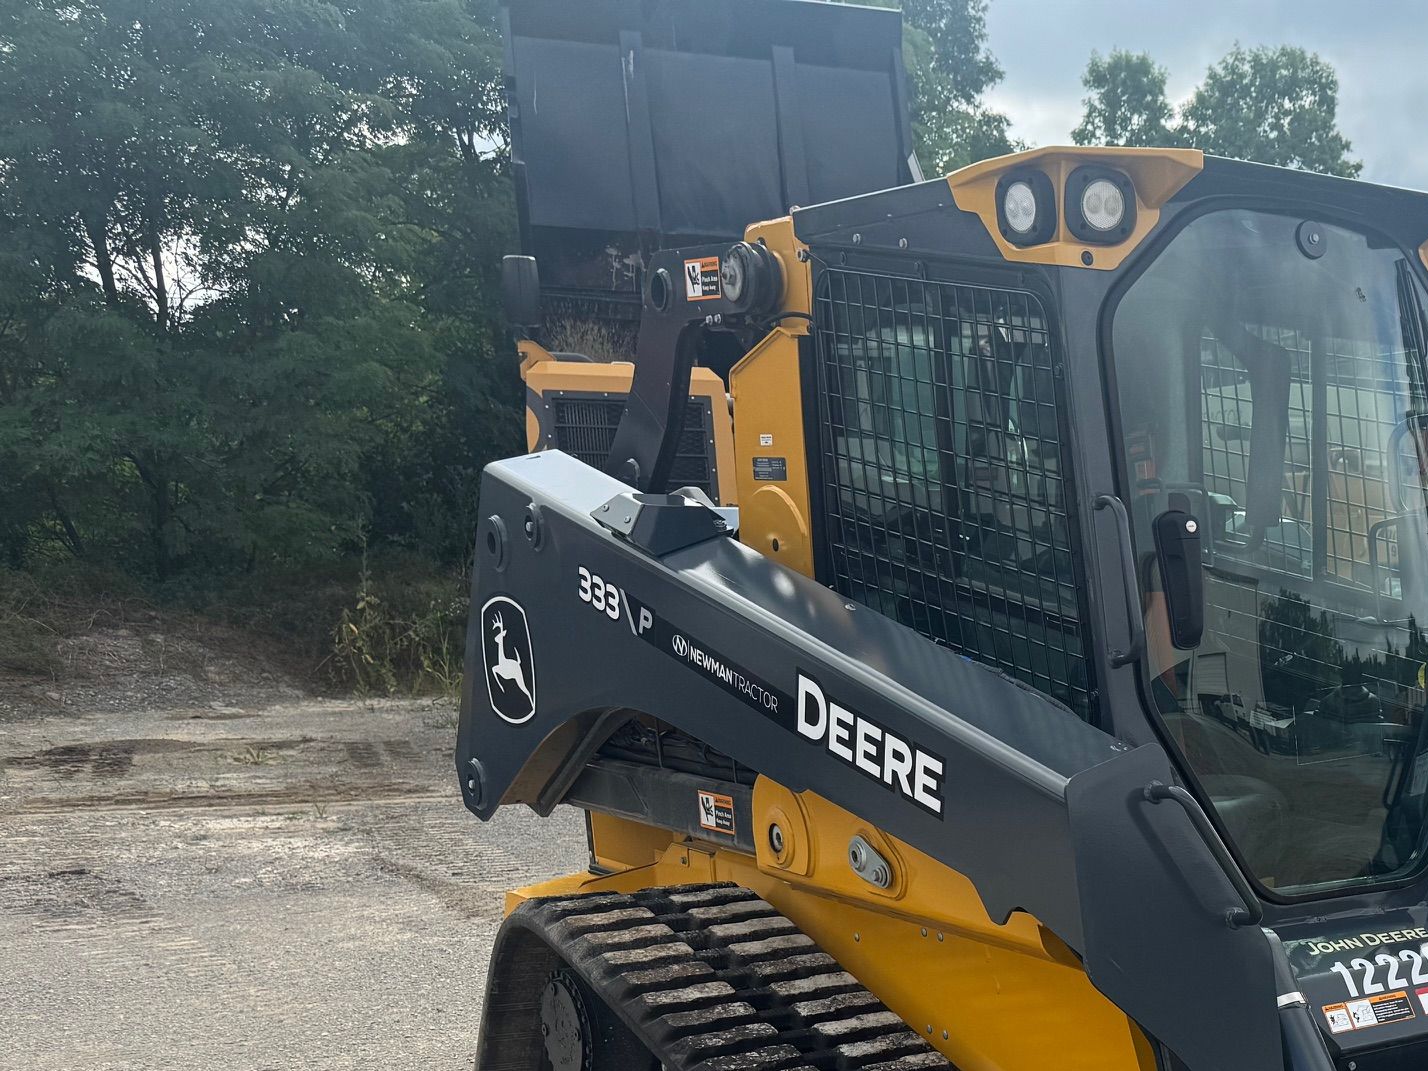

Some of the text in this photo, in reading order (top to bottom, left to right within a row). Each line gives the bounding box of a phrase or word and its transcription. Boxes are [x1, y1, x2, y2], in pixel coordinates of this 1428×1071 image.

[578, 566, 654, 636] 333 P
[689, 646, 779, 714] NEWMANTRACTOR
[796, 673, 944, 813] DEERE
[1307, 938, 1364, 956] JOHN
